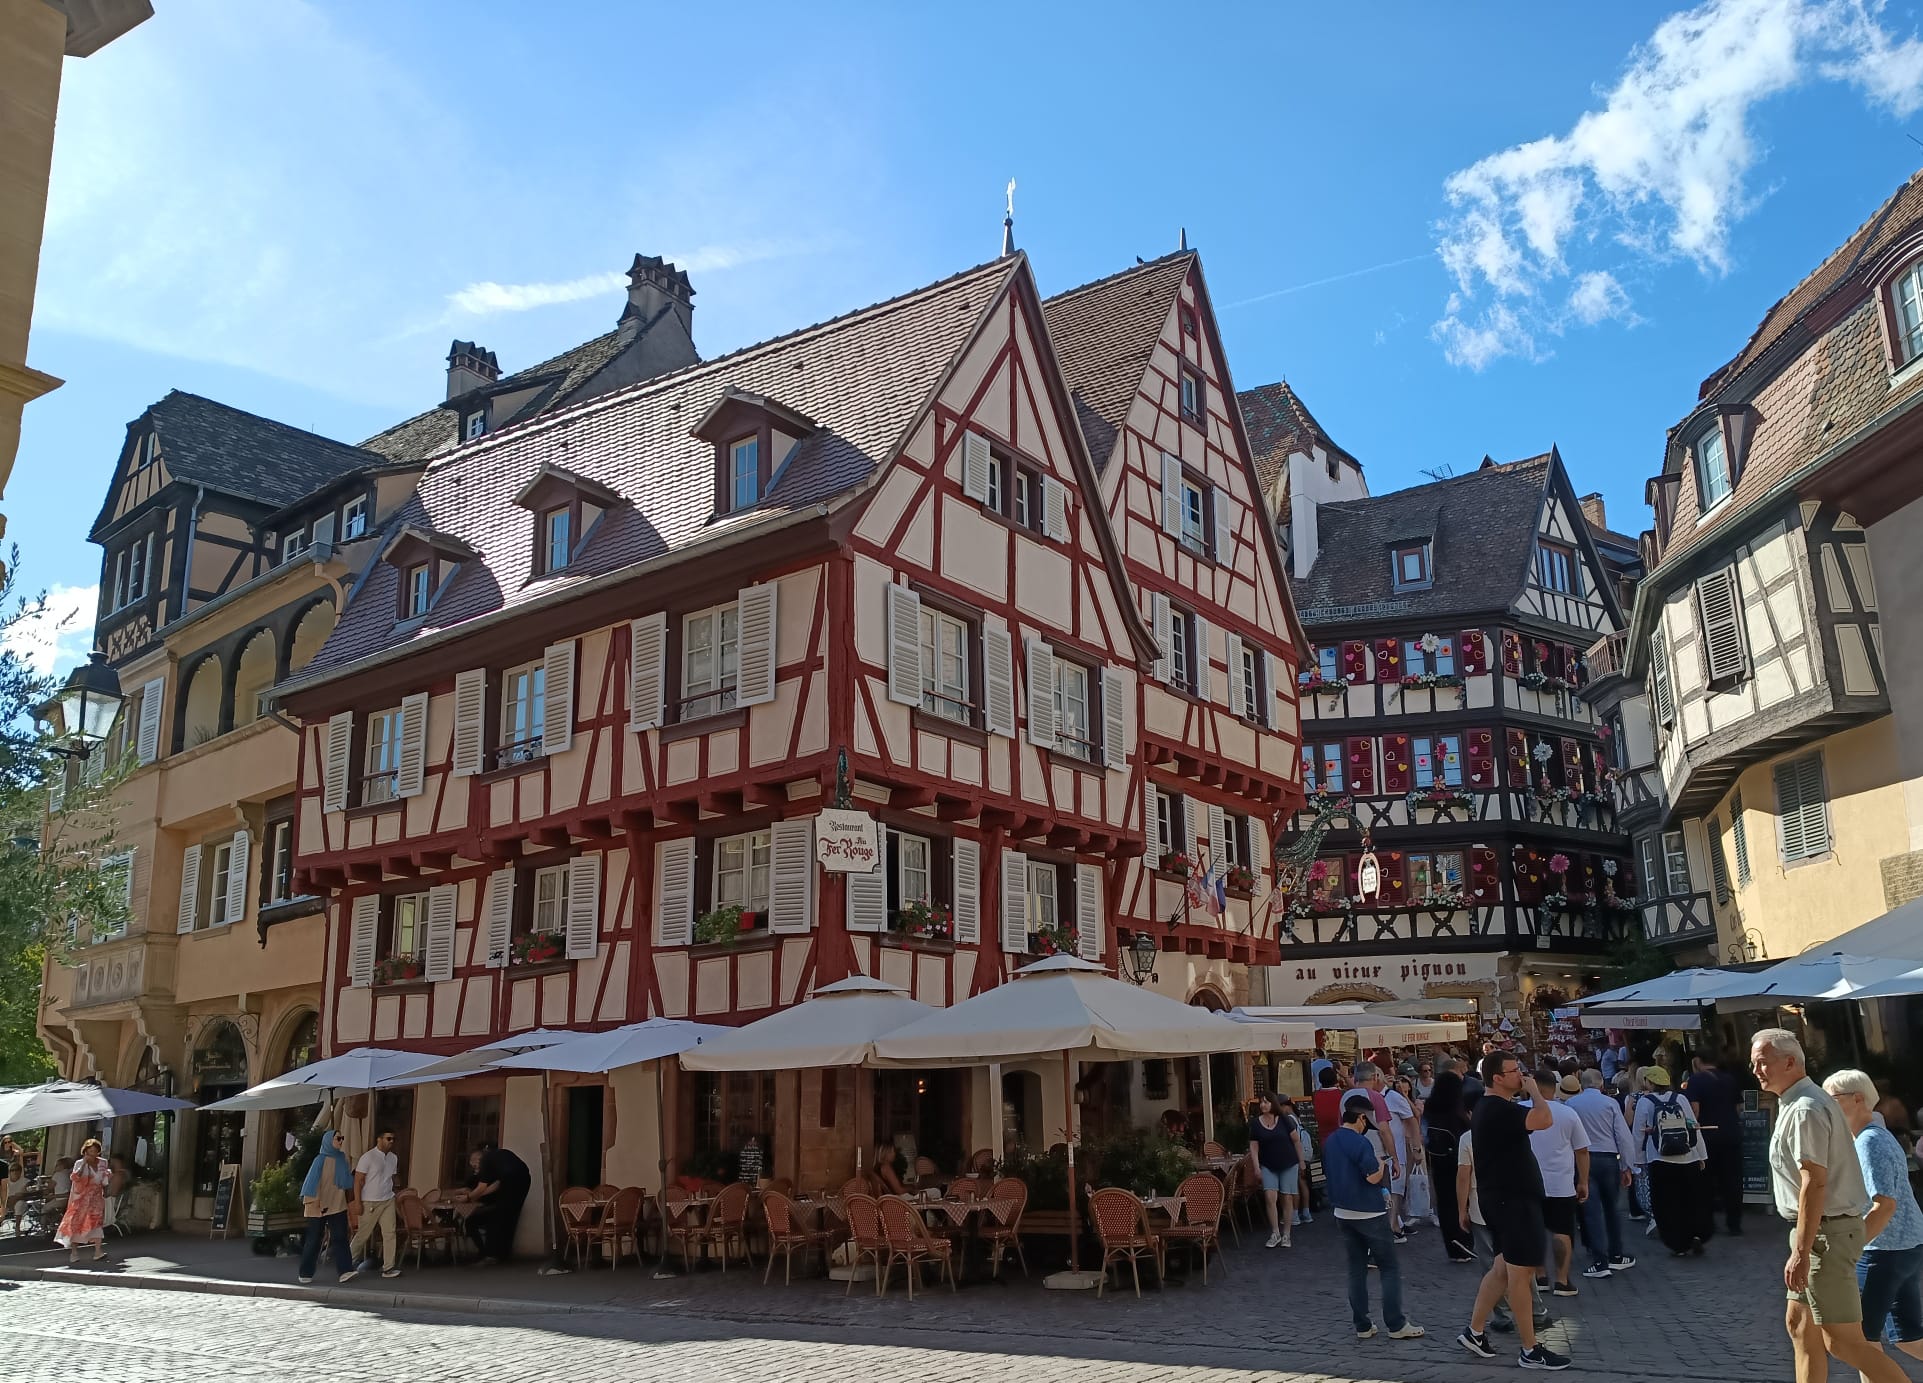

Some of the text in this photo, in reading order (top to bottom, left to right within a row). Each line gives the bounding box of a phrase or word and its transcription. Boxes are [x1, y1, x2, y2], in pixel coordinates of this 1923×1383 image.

[829, 820, 863, 832] Restaurant
[819, 837, 874, 861] Fer Rouge
[1295, 968, 1316, 980] au
[1400, 958, 1466, 982] pignon
